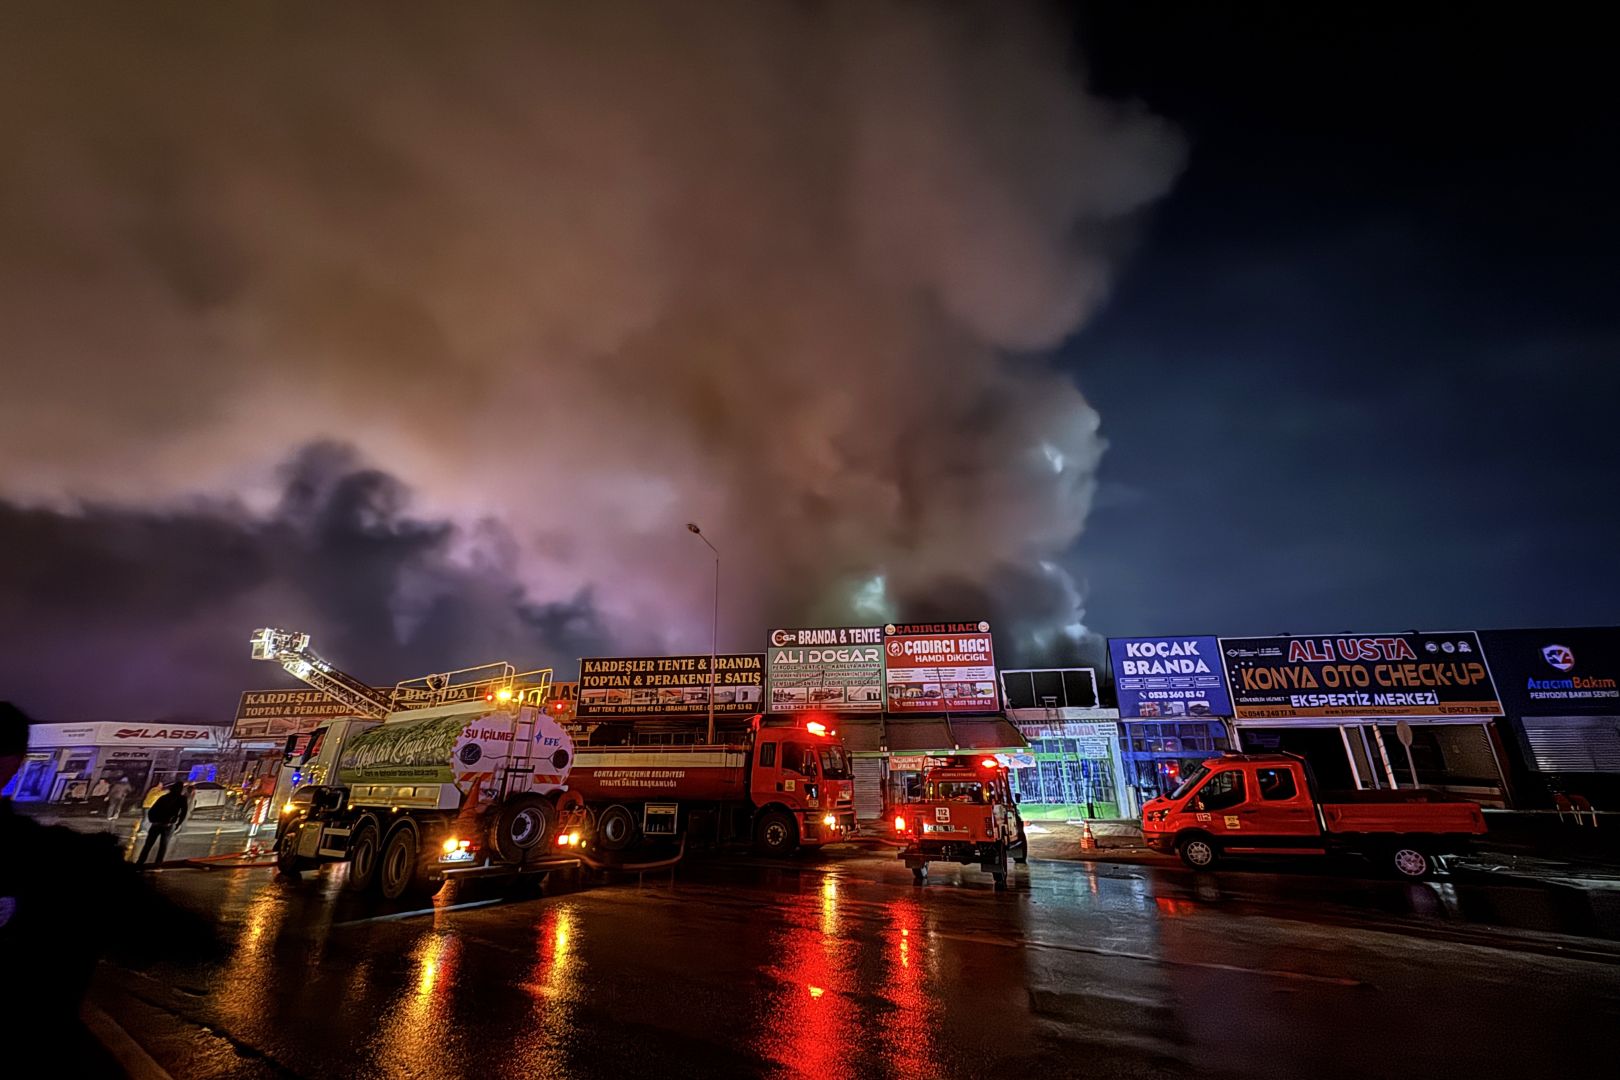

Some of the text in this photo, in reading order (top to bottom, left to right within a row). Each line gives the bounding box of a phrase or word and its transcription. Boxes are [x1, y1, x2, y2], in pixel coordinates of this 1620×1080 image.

[947, 623, 978, 632] HACI
[798, 629, 838, 645] BRANDA
[839, 629, 848, 643] &
[849, 628, 881, 643] TENTE
[904, 638, 990, 656] ÇADIRCI HACI
[1126, 641, 1200, 658] KOÇAK
[1337, 637, 1418, 661] USTA
[585, 657, 761, 675] KARDEŞLER TENTE & BRANDA
[1122, 658, 1211, 675] BRANDA
[584, 672, 761, 687] TOPTAN & PERAKENDE SATIŞ
[1241, 666, 1319, 690] KONYA
[1321, 664, 1370, 688] OTO
[1374, 662, 1486, 687] CHECK-UP
[245, 691, 333, 705] KARDEŞLER
[1290, 689, 1439, 707] EKSPERTİZ MERKEZİ
[244, 707, 281, 717] TOPTAN
[282, 706, 292, 716] &
[139, 728, 210, 740] LASSA
[465, 728, 478, 739] SU
[543, 737, 560, 746] EFE
[937, 808, 948, 816] 112
